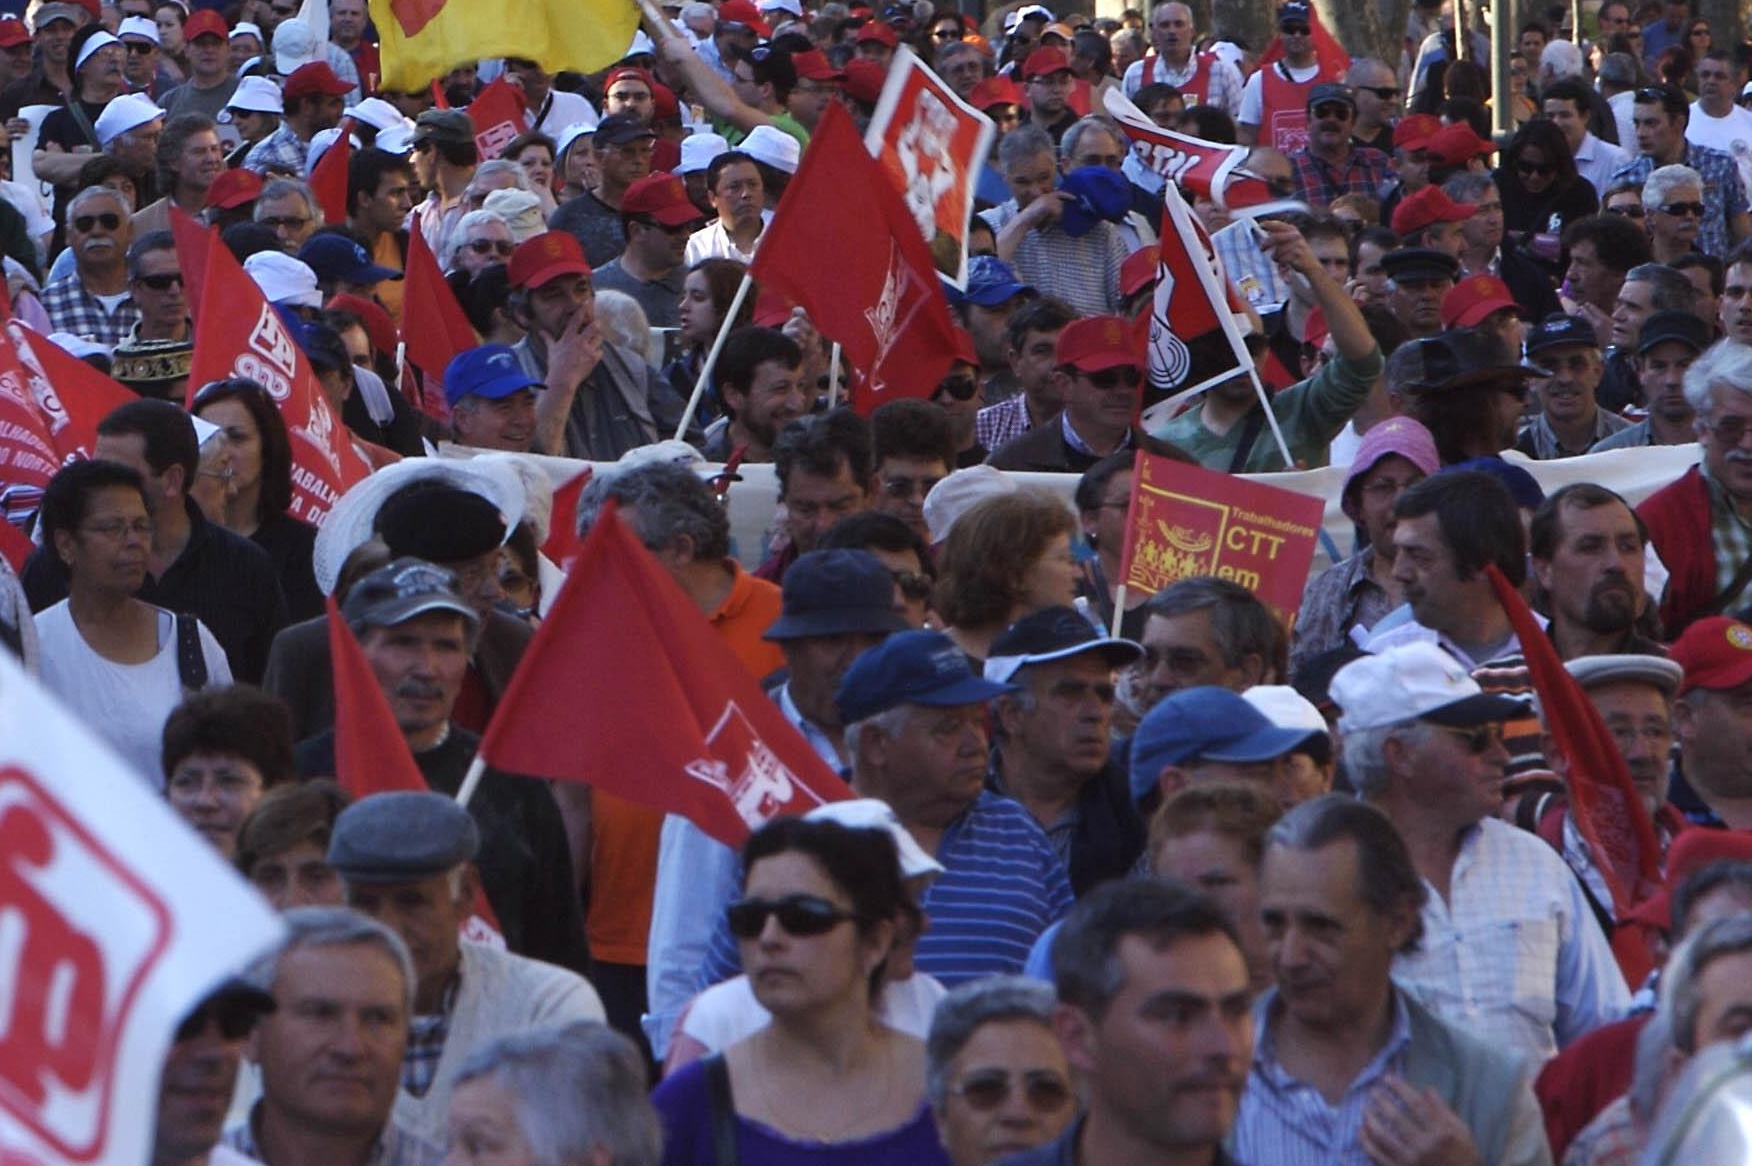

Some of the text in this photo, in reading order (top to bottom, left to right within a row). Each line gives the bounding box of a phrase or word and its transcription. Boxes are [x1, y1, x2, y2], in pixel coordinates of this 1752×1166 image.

[1231, 506, 1315, 538] Trabalhadores
[1225, 525, 1287, 560] CTT
[1217, 564, 1261, 592] em
